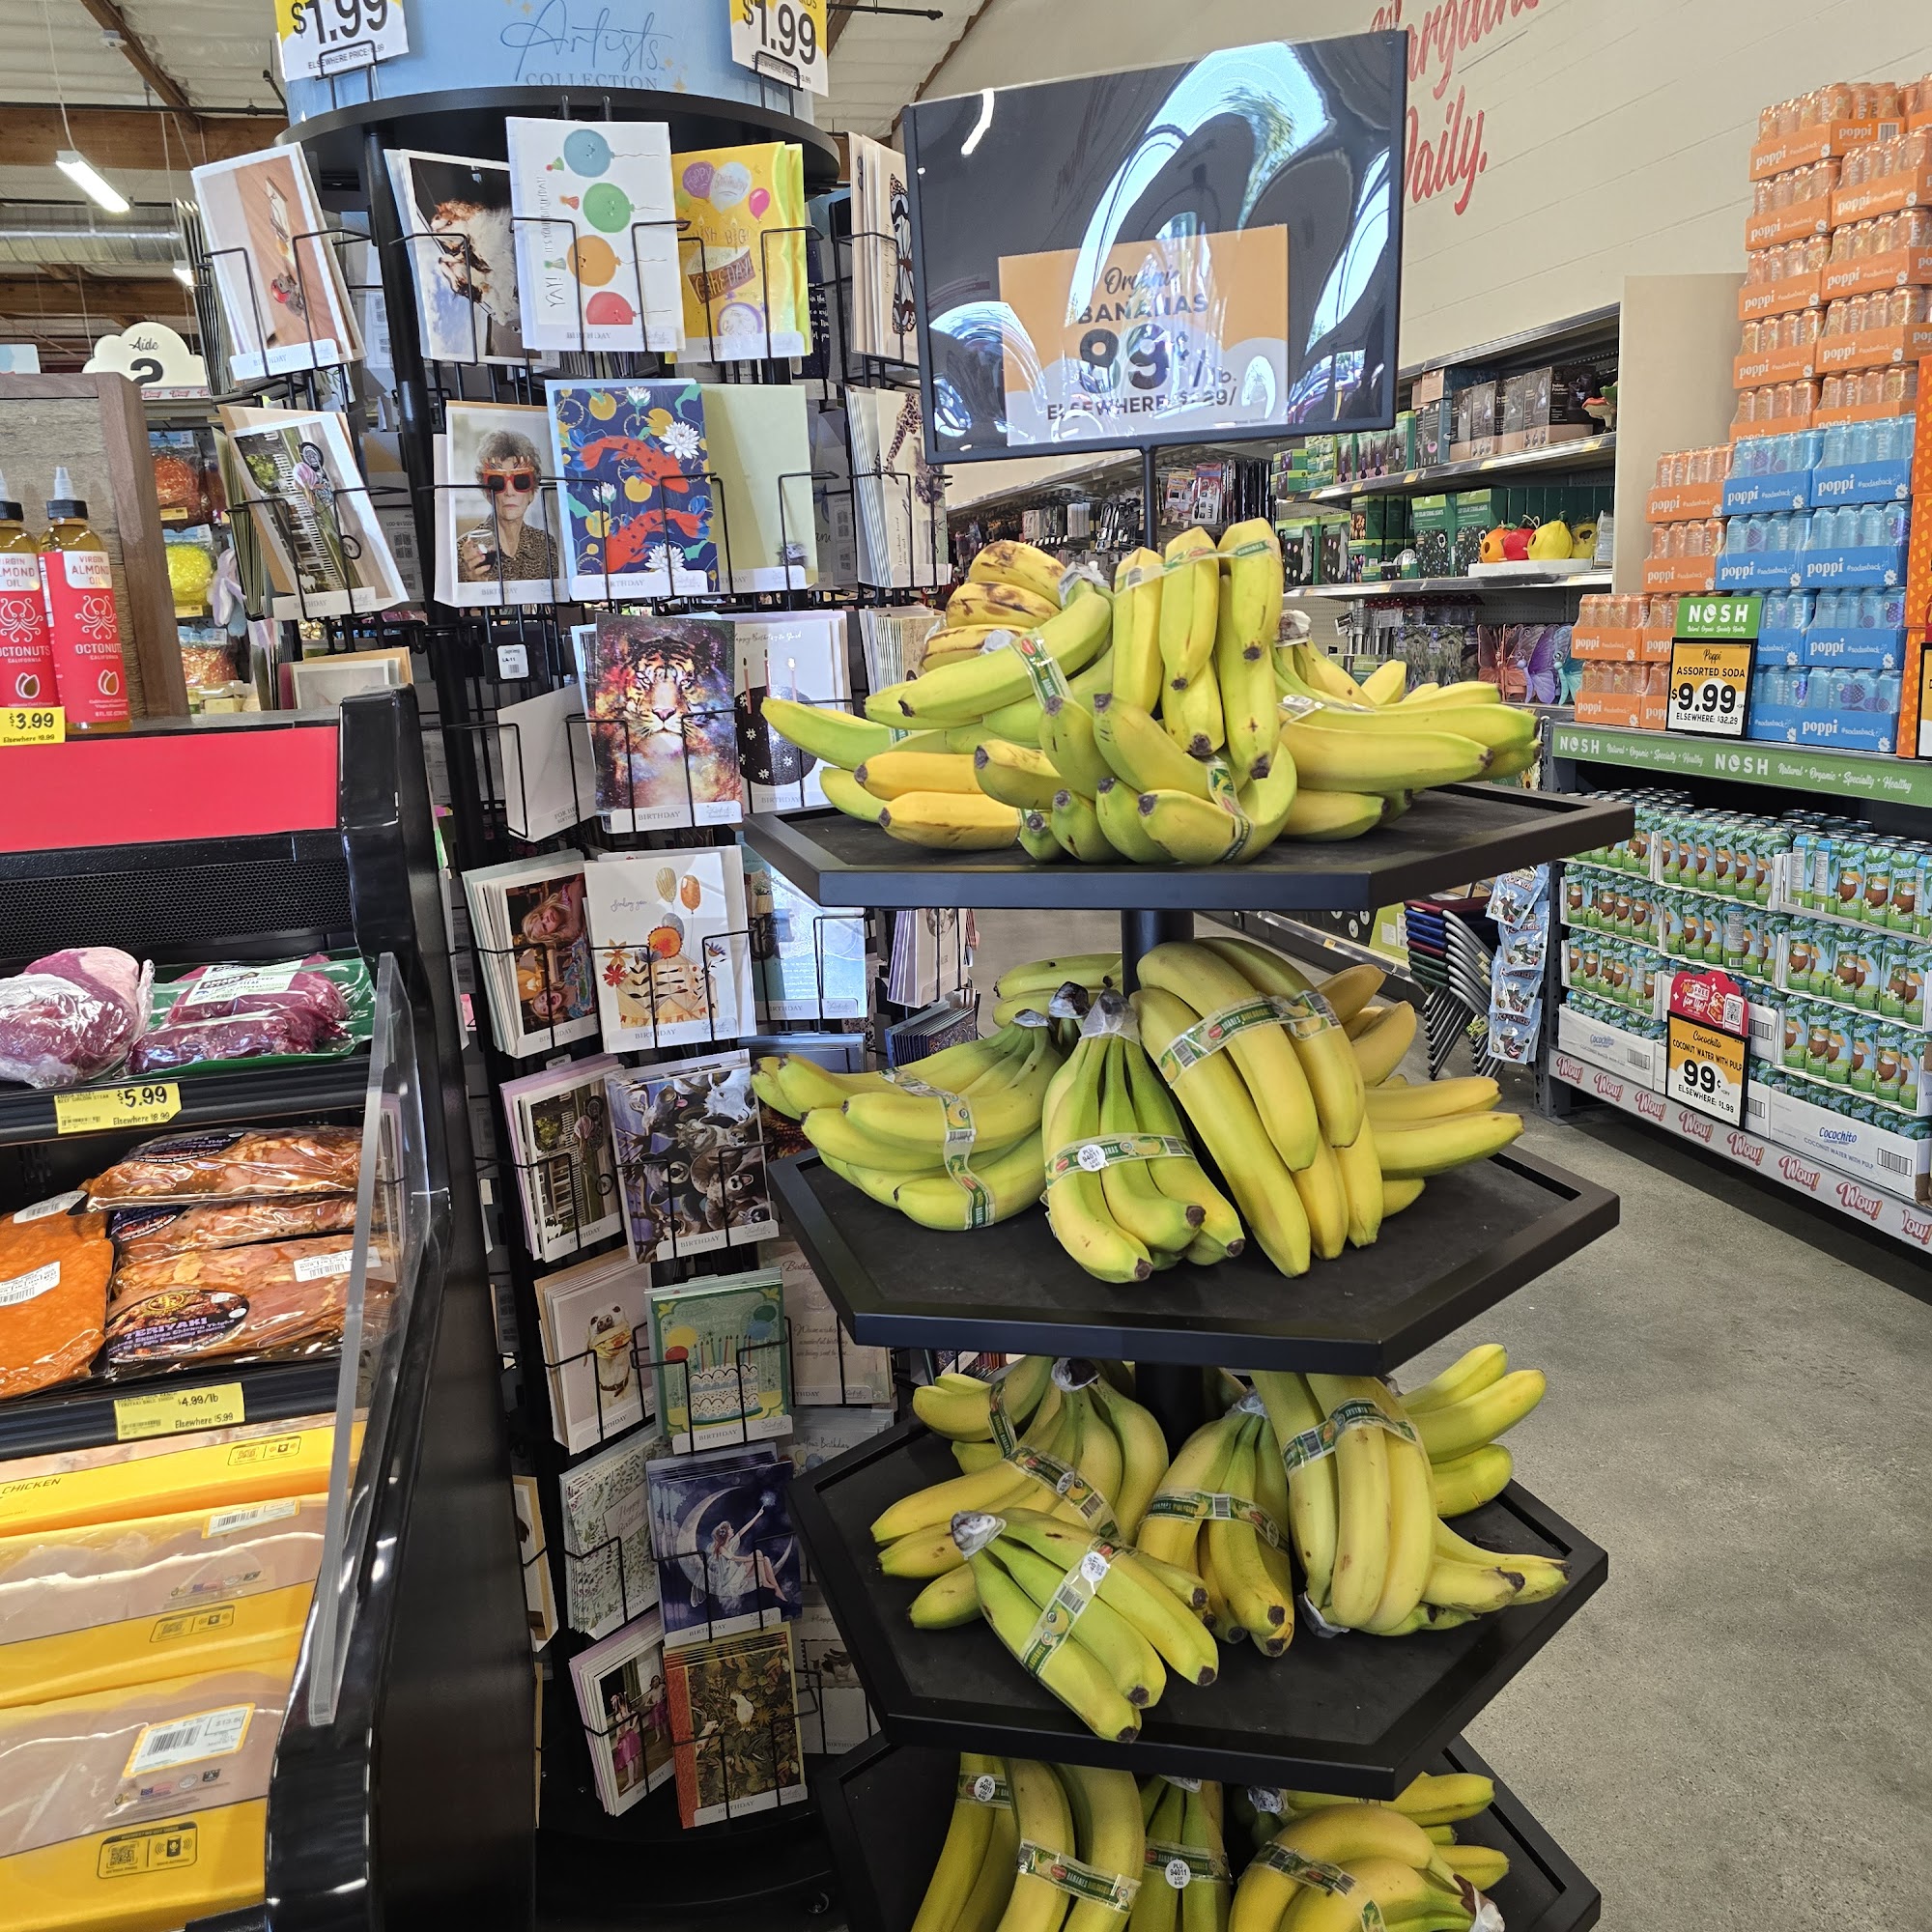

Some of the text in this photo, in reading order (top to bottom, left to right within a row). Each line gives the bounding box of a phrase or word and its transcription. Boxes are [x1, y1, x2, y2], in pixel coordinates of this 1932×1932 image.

[1839, 124, 1872, 139] poppi
[1756, 145, 1786, 170] poppi
[1837, 190, 1870, 214] poppi
[1751, 218, 1780, 242] poppi
[1828, 267, 1860, 290] poppi
[545, 276, 566, 307] YAY!
[1745, 290, 1775, 312] poppi
[1078, 293, 1209, 325] BANANAS
[1823, 342, 1856, 362] poppi
[1739, 359, 1770, 380] poppi
[1818, 474, 1855, 497] poppi
[1651, 495, 1680, 514] poppi
[1728, 486, 1759, 505] poppi
[71, 565, 110, 575] ALMOND
[1648, 567, 1674, 583] poppi
[1721, 561, 1754, 580] poppi
[1807, 557, 1844, 577] poppi
[6, 579, 22, 587] OIL
[1688, 604, 1748, 624] NOSH
[1576, 636, 1600, 650] poppi
[1646, 639, 1671, 653] popp
[1810, 638, 1844, 656] poppi
[1676, 666, 1746, 678] ASSORTED SODA
[1577, 700, 1602, 714] poppi
[1671, 682, 1737, 713] $9.99
[10, 713, 54, 730] $3.99
[1676, 712, 1739, 725] ELSEWHERE: $32.29
[1803, 719, 1839, 736] poppi
[1560, 735, 1912, 794] NOSH Natural Organic Specialty Healthy NOSH Natural Organic Specialty Healthy
[761, 795, 801, 805] BIRTHDAY
[554, 810, 568, 820] FOR
[638, 810, 680, 821] BIRTHDAY
[1694, 986, 1709, 996] FREE
[1693, 1030, 1722, 1049] Cocochito
[1672, 1038, 1743, 1071] COCONUT WATER WITH PULP
[1556, 1056, 1583, 1084] Wow!
[1683, 1059, 1722, 1094] 99¢
[1594, 1072, 1624, 1102] Wow!
[117, 1086, 167, 1108] $5.99
[1634, 1091, 1666, 1122] Wow!
[1678, 1084, 1734, 1114] ELSEWHERE: $1.99
[113, 1116, 149, 1125] Elsewhere
[1678, 1109, 1714, 1143] Wow!
[1819, 1126, 1858, 1144] Cocochito
[1726, 1131, 1765, 1166] Wow!
[1804, 1137, 1874, 1169] COCONUT WATER WITH PULP
[1778, 1155, 1821, 1191] Wow!
[1836, 1181, 1883, 1221] Wow!
[680, 1235, 720, 1248] BIRTHDAY
[124, 1317, 208, 1340] TERIYAKI
[178, 1392, 218, 1406] $4.99/lb
[175, 1416, 213, 1430] Elsewhere
[698, 1429, 737, 1441] BIRTHDAY
[1, 1477, 62, 1494] CHICKEN
